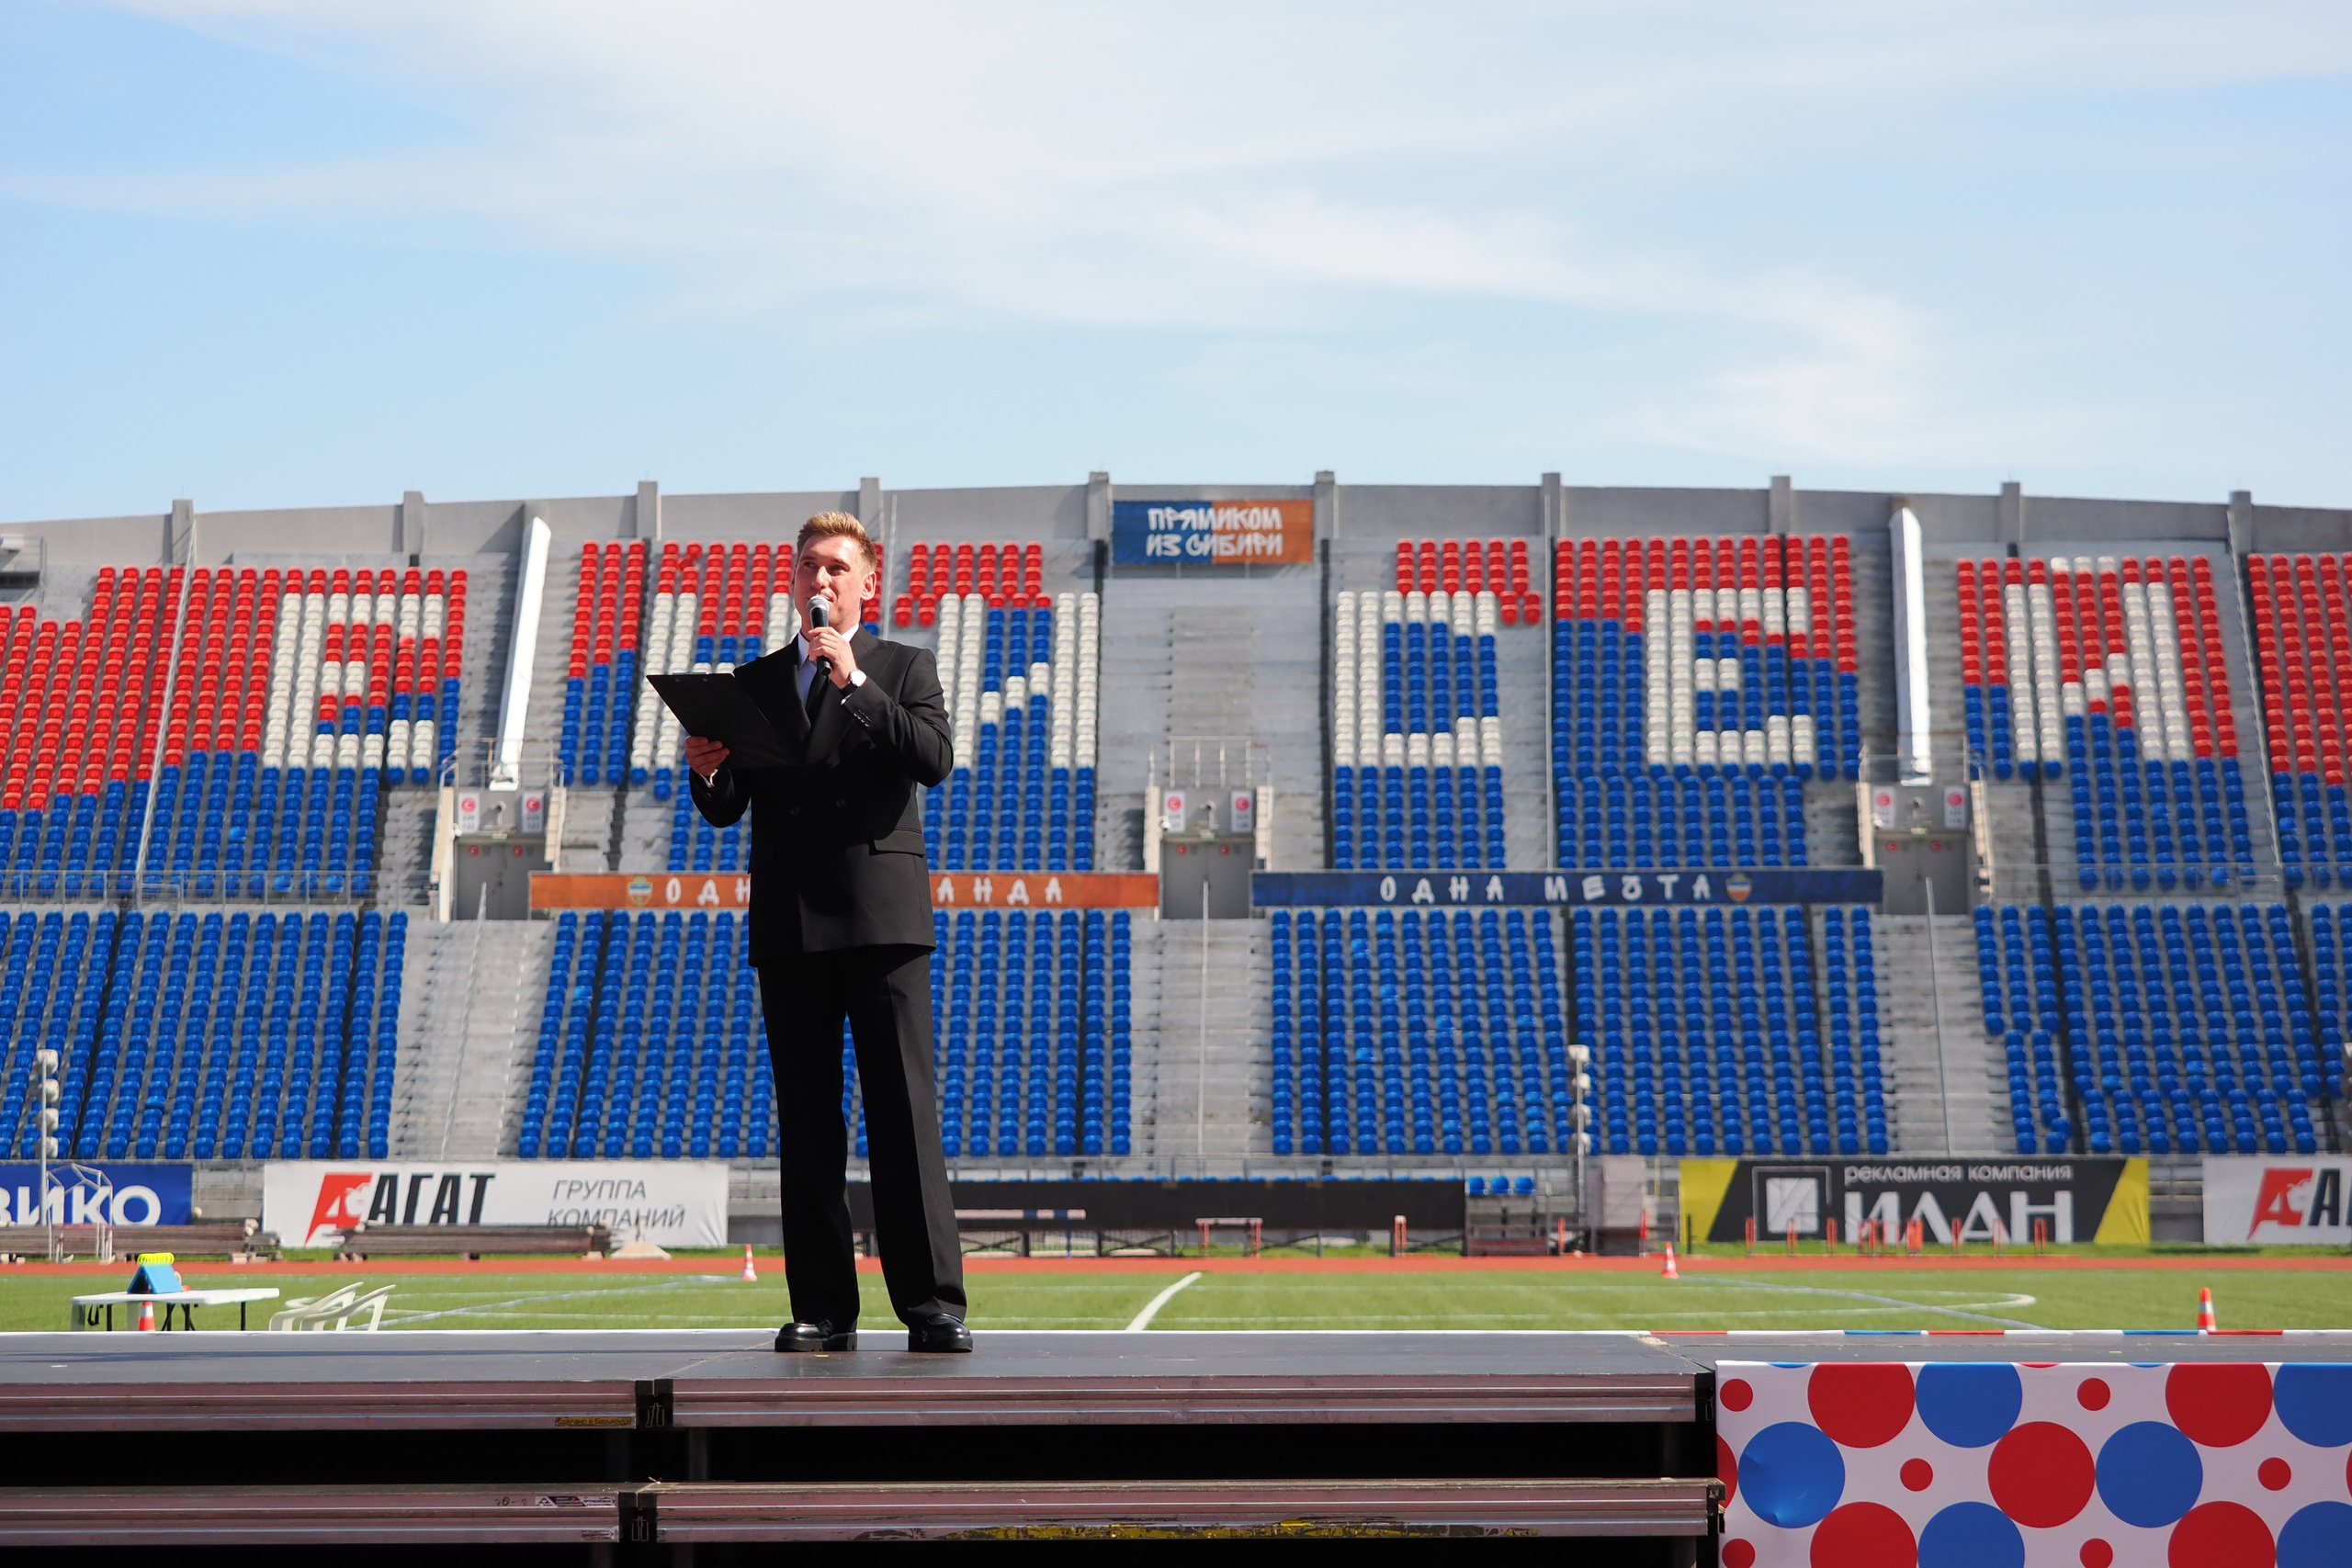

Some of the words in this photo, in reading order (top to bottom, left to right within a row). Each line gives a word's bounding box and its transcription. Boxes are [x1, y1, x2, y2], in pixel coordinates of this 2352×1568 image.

[1148, 507, 1283, 530] ПРЯМИКОМ
[1146, 533, 1182, 557] ИЗ
[1185, 532, 1283, 557] СИБИРИ
[665, 877, 751, 906] ОДН
[936, 876, 1062, 906] АНДА
[1380, 875, 1504, 904] ОДНА
[1844, 1165, 1963, 1187] рекламная
[1967, 1165, 2074, 1182] компания
[368, 1173, 495, 1225] АГАТ
[553, 1179, 647, 1200] ГРУППА
[548, 1203, 686, 1228] КОМПАНИЙ
[1844, 1190, 2075, 1245] ИЛАН
